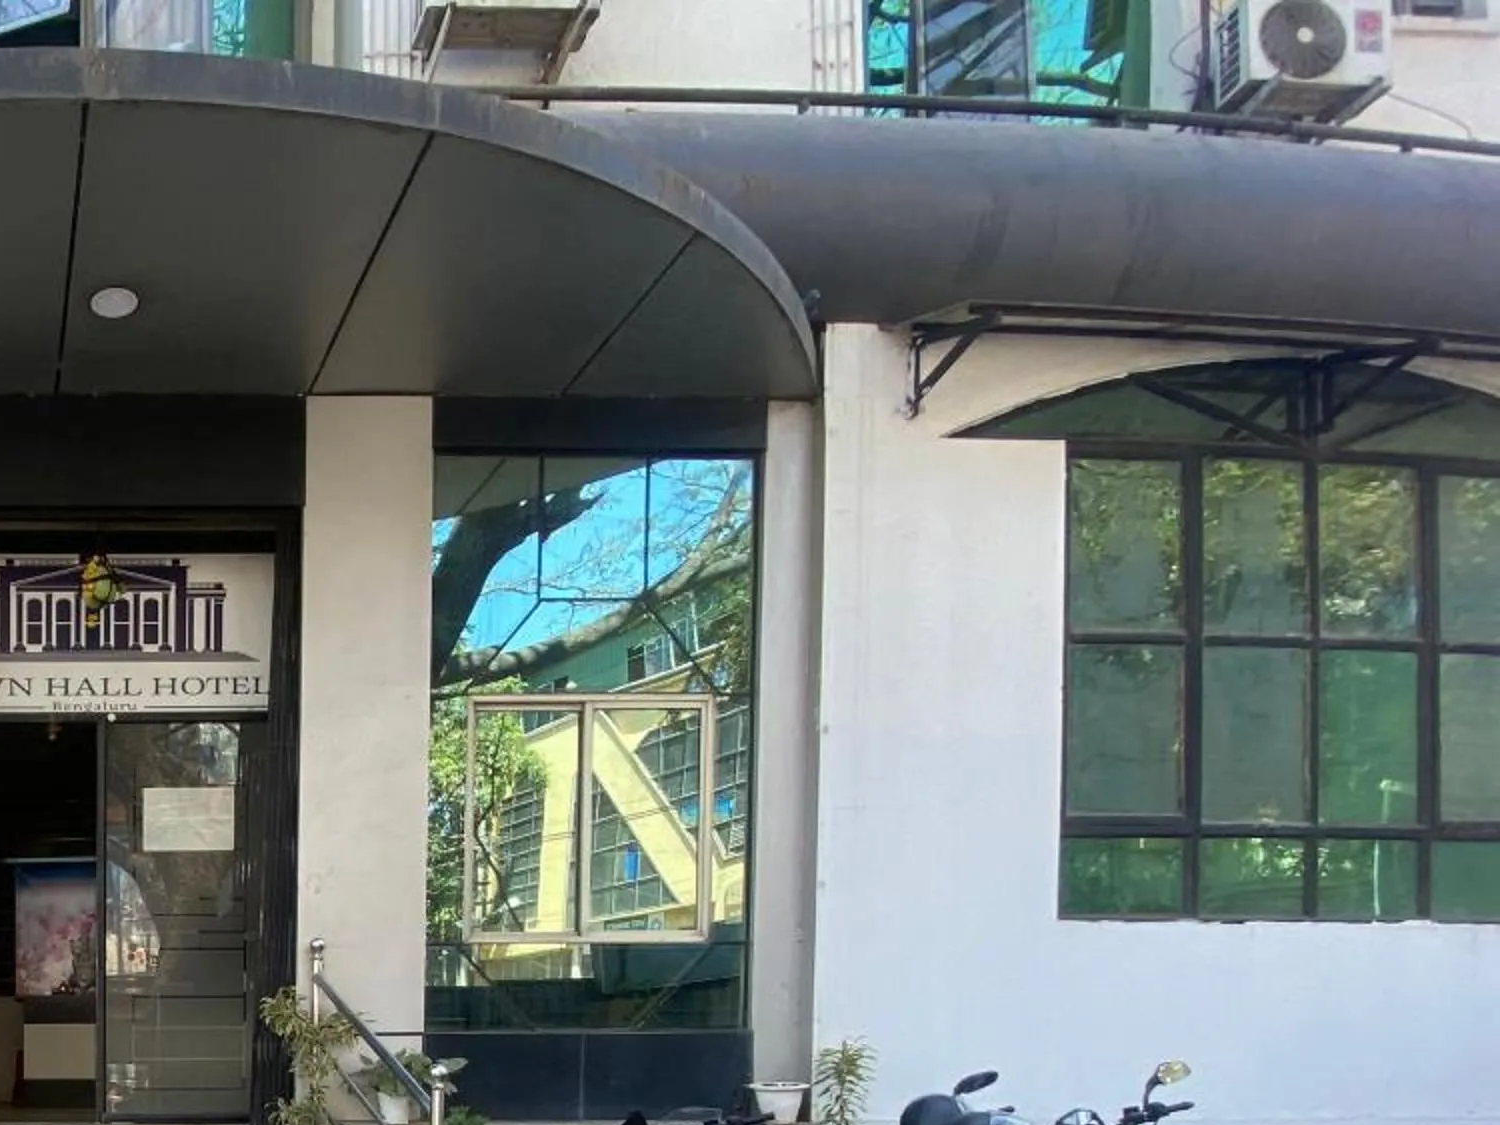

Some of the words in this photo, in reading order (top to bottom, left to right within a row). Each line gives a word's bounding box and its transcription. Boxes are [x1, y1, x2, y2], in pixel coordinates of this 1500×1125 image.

[46, 677, 143, 697] HALL
[153, 675, 271, 696] HOTEL
[52, 700, 138, 712] Bengaluru
